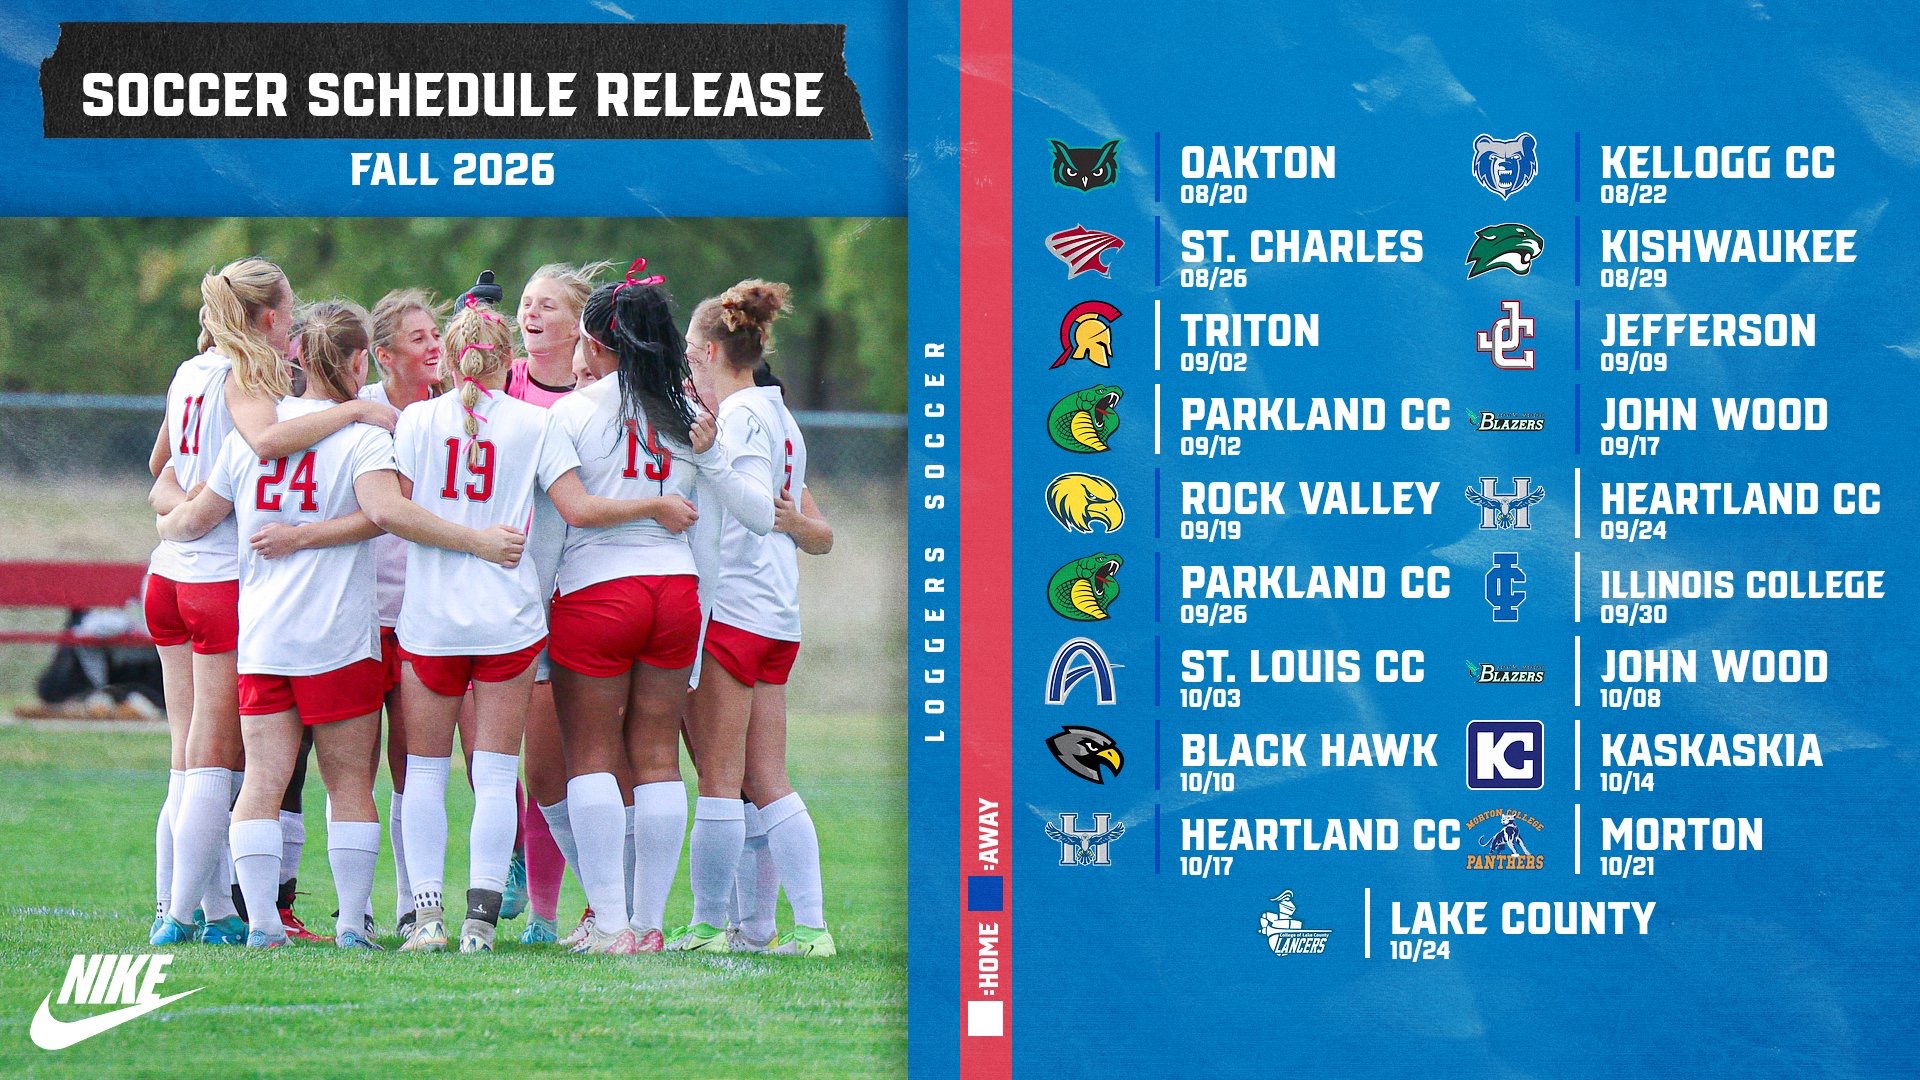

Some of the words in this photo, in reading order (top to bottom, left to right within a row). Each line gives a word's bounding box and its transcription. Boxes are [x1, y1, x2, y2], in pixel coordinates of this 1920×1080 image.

[254, 449, 319, 513] 24
[440, 436, 497, 503] 19
[621, 418, 673, 482] 15
